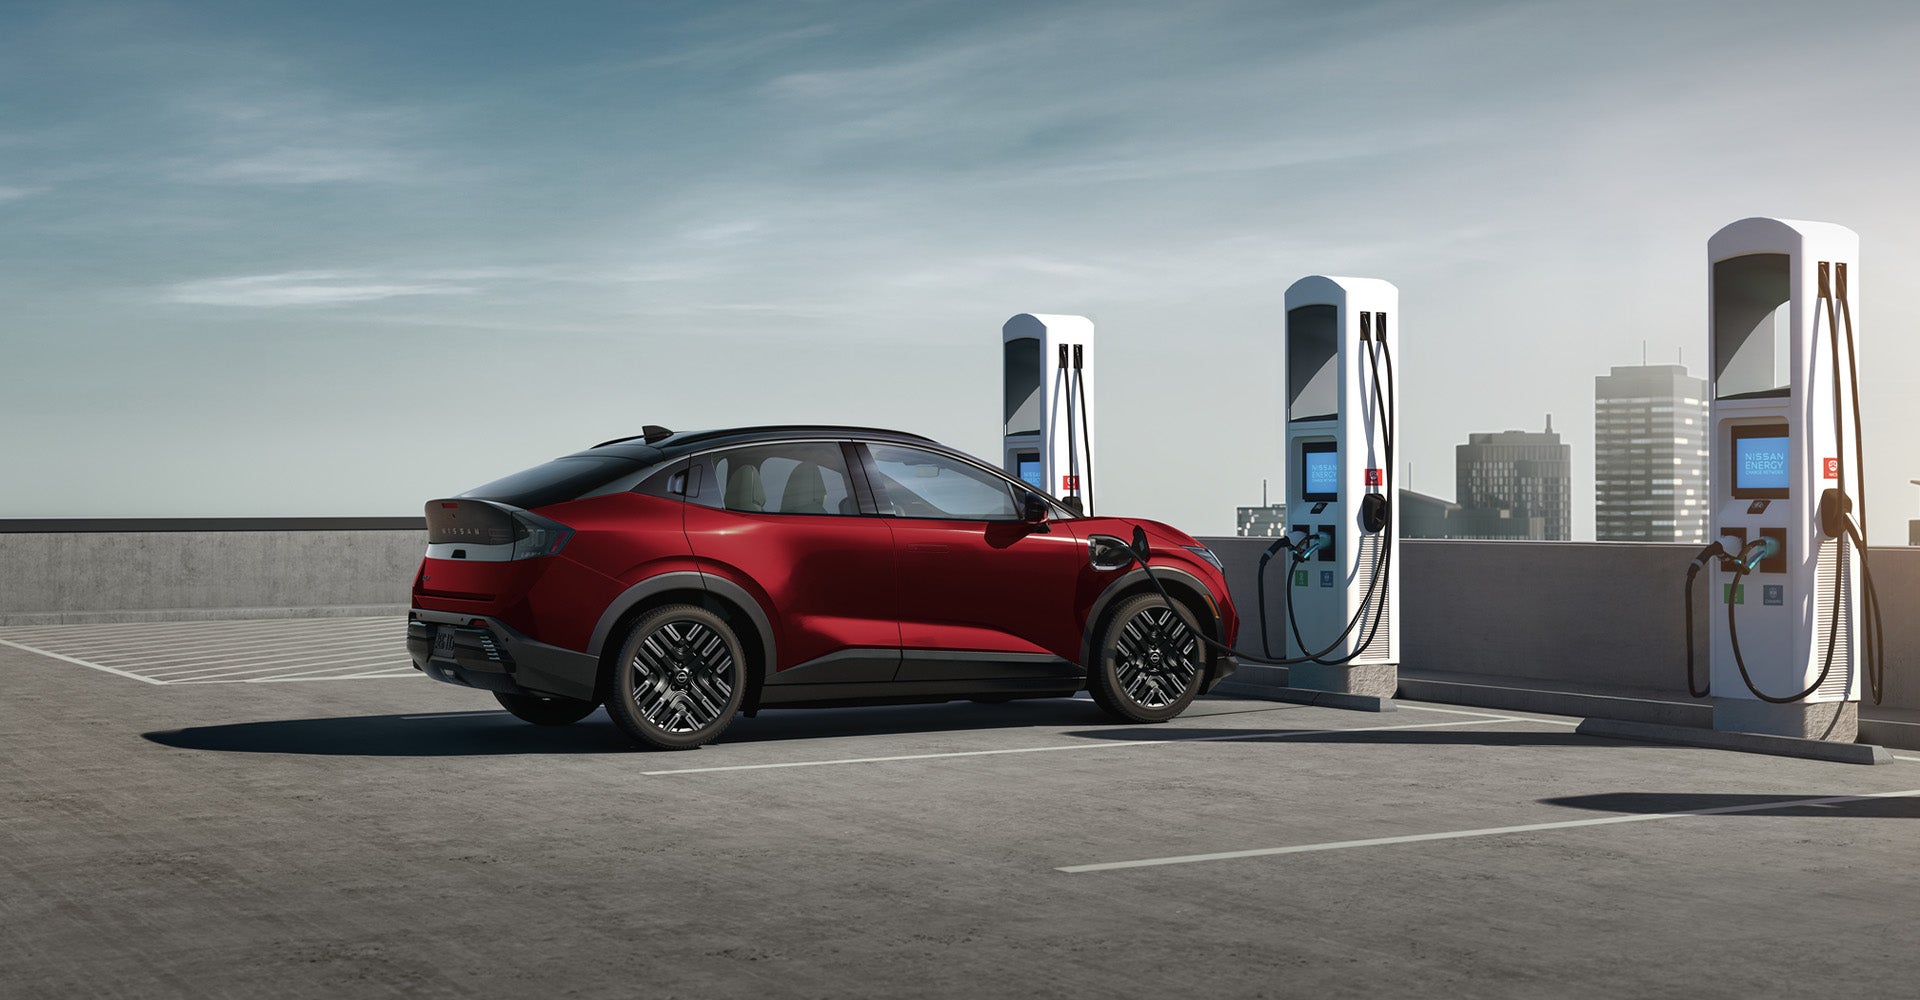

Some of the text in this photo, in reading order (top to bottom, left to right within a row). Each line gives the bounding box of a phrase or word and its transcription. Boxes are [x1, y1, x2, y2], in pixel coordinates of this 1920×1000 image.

[1745, 453, 1784, 461] NISSAN
[1745, 461, 1784, 470] ENERGY
[442, 527, 480, 535] NISSAN
